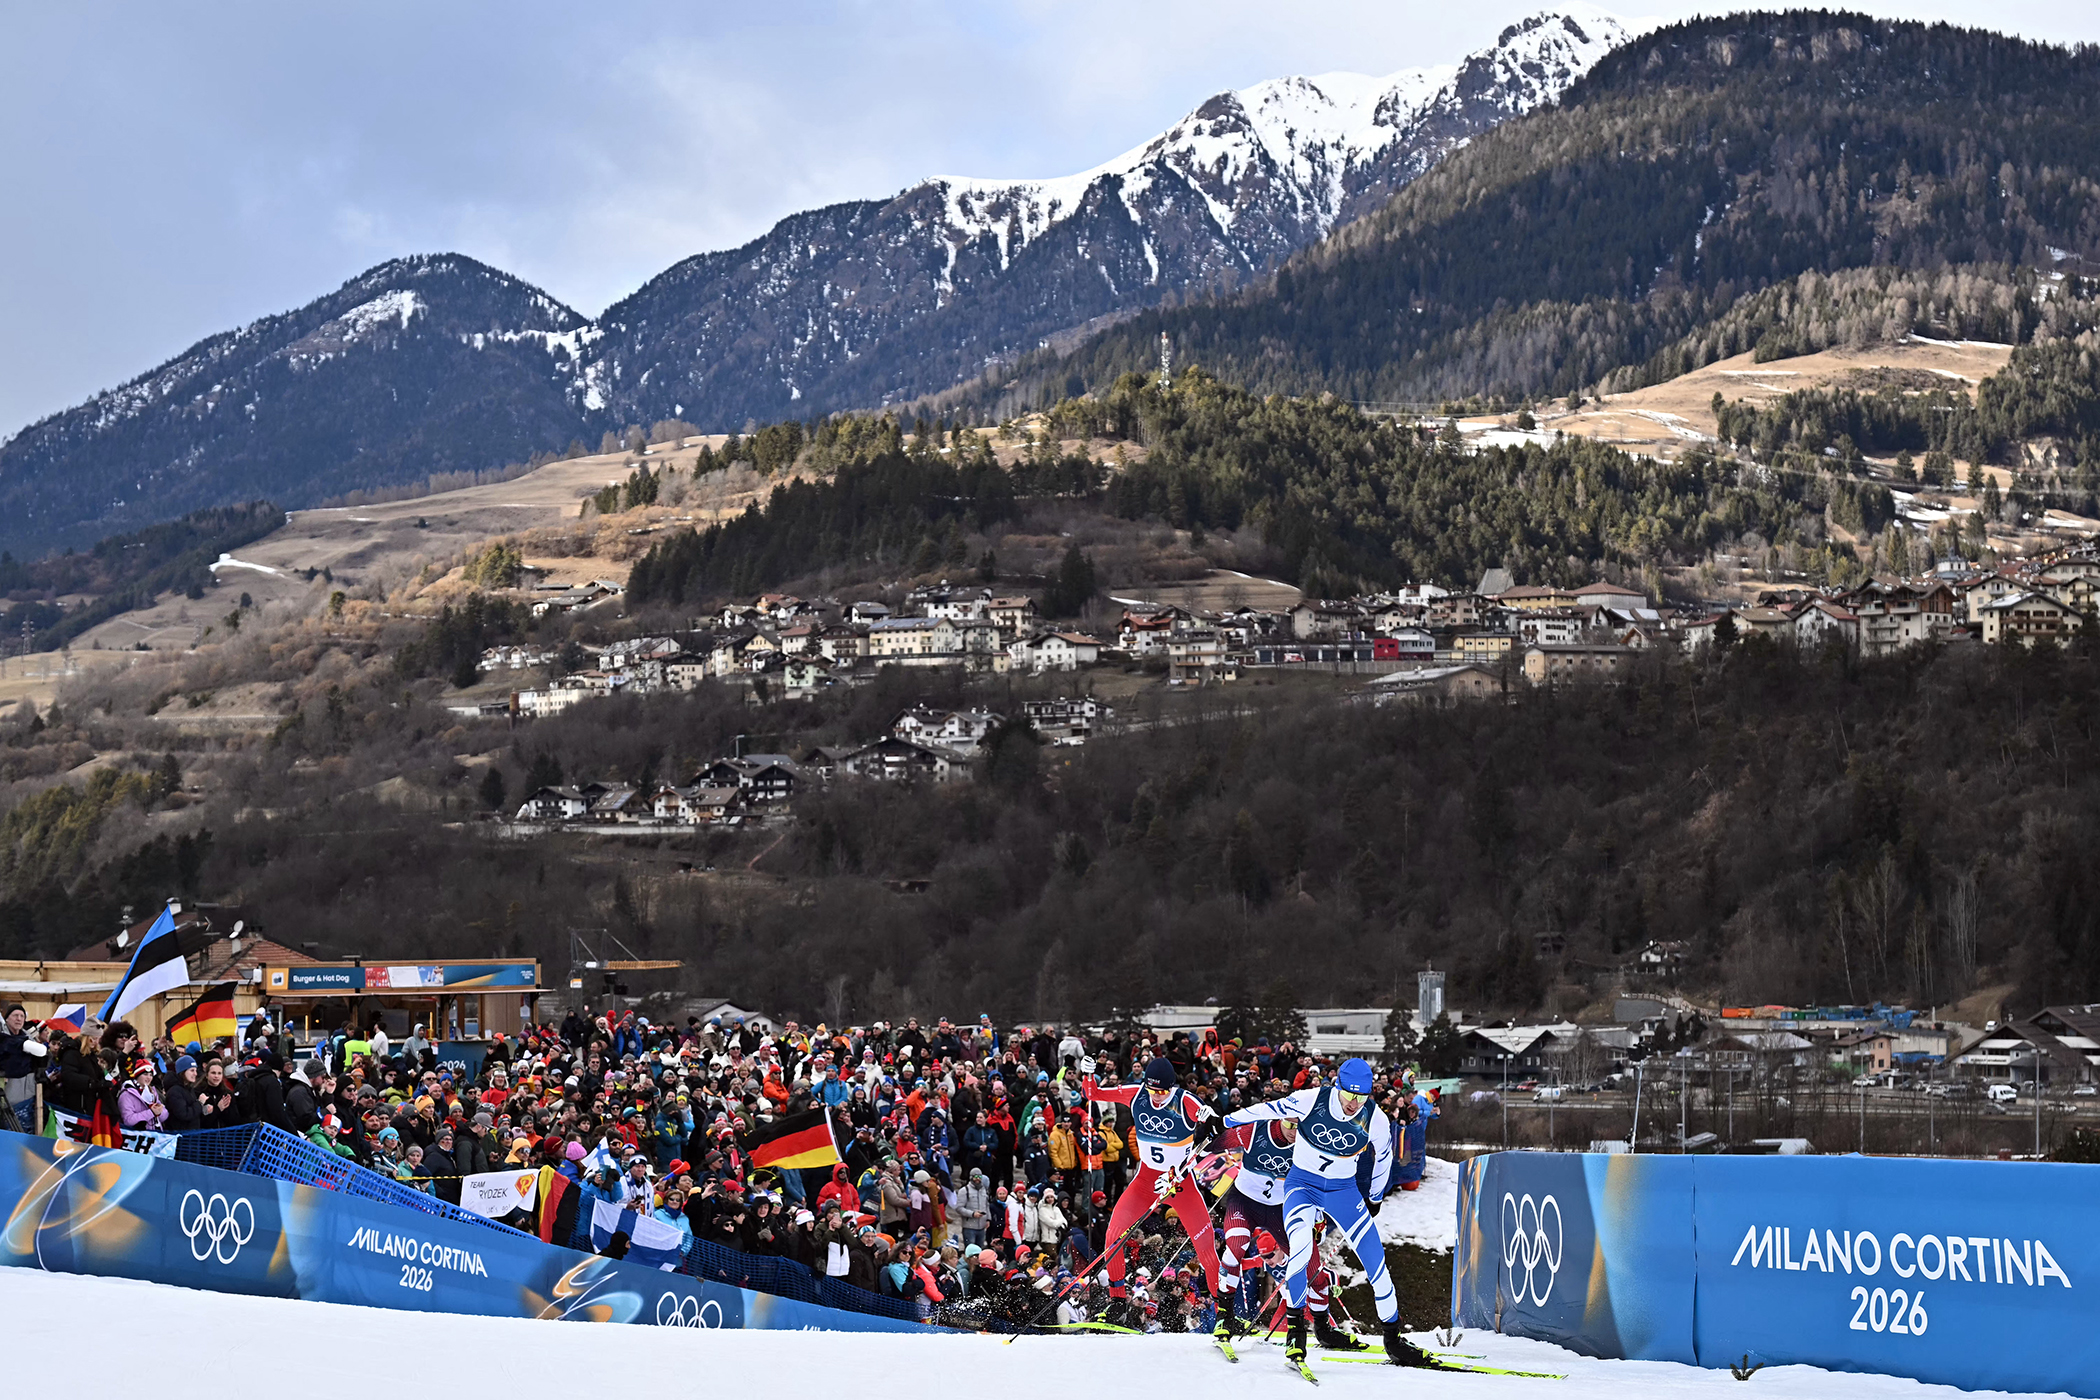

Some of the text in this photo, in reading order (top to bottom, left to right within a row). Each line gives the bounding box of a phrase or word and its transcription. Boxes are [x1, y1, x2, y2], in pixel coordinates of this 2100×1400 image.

[293, 975, 315, 984] Burger
[335, 974, 350, 984] Dog
[1150, 1145, 1165, 1164] 5
[1318, 1154, 1335, 1173] 7
[479, 1188, 508, 1200] RYDZEK
[1262, 1180, 1274, 1199] 2
[347, 1226, 489, 1278] MILANO CORTINA
[1730, 1224, 2073, 1289] MILANO CORTINA
[399, 1264, 433, 1292] 2026
[1849, 1285, 1928, 1336] 2026
